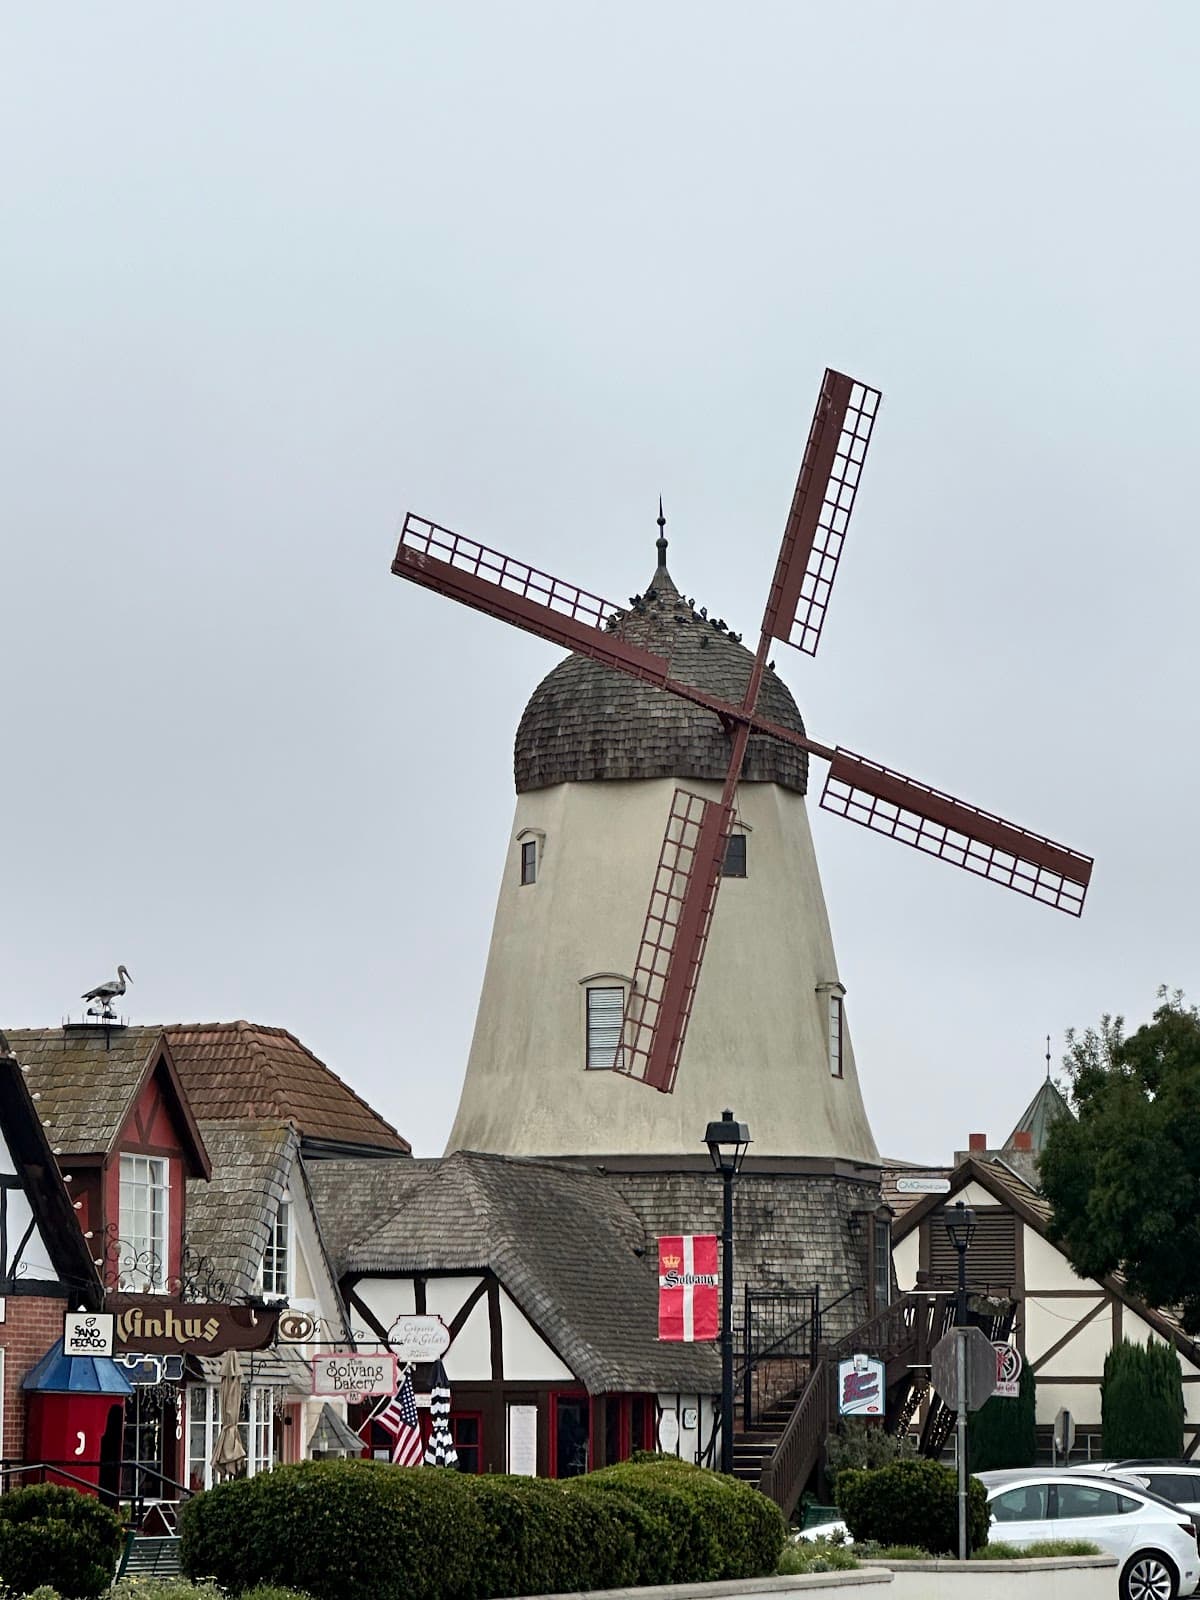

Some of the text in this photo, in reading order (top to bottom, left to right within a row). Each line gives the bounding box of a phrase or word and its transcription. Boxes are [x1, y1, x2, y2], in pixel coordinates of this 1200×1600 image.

[664, 1271, 714, 1287] Solvang
[74, 1325, 100, 1338] SANO
[117, 1308, 220, 1343] Vinhus
[71, 1337, 107, 1348] PECADO
[327, 1361, 384, 1381] Solvang
[334, 1377, 376, 1392] Bakery
